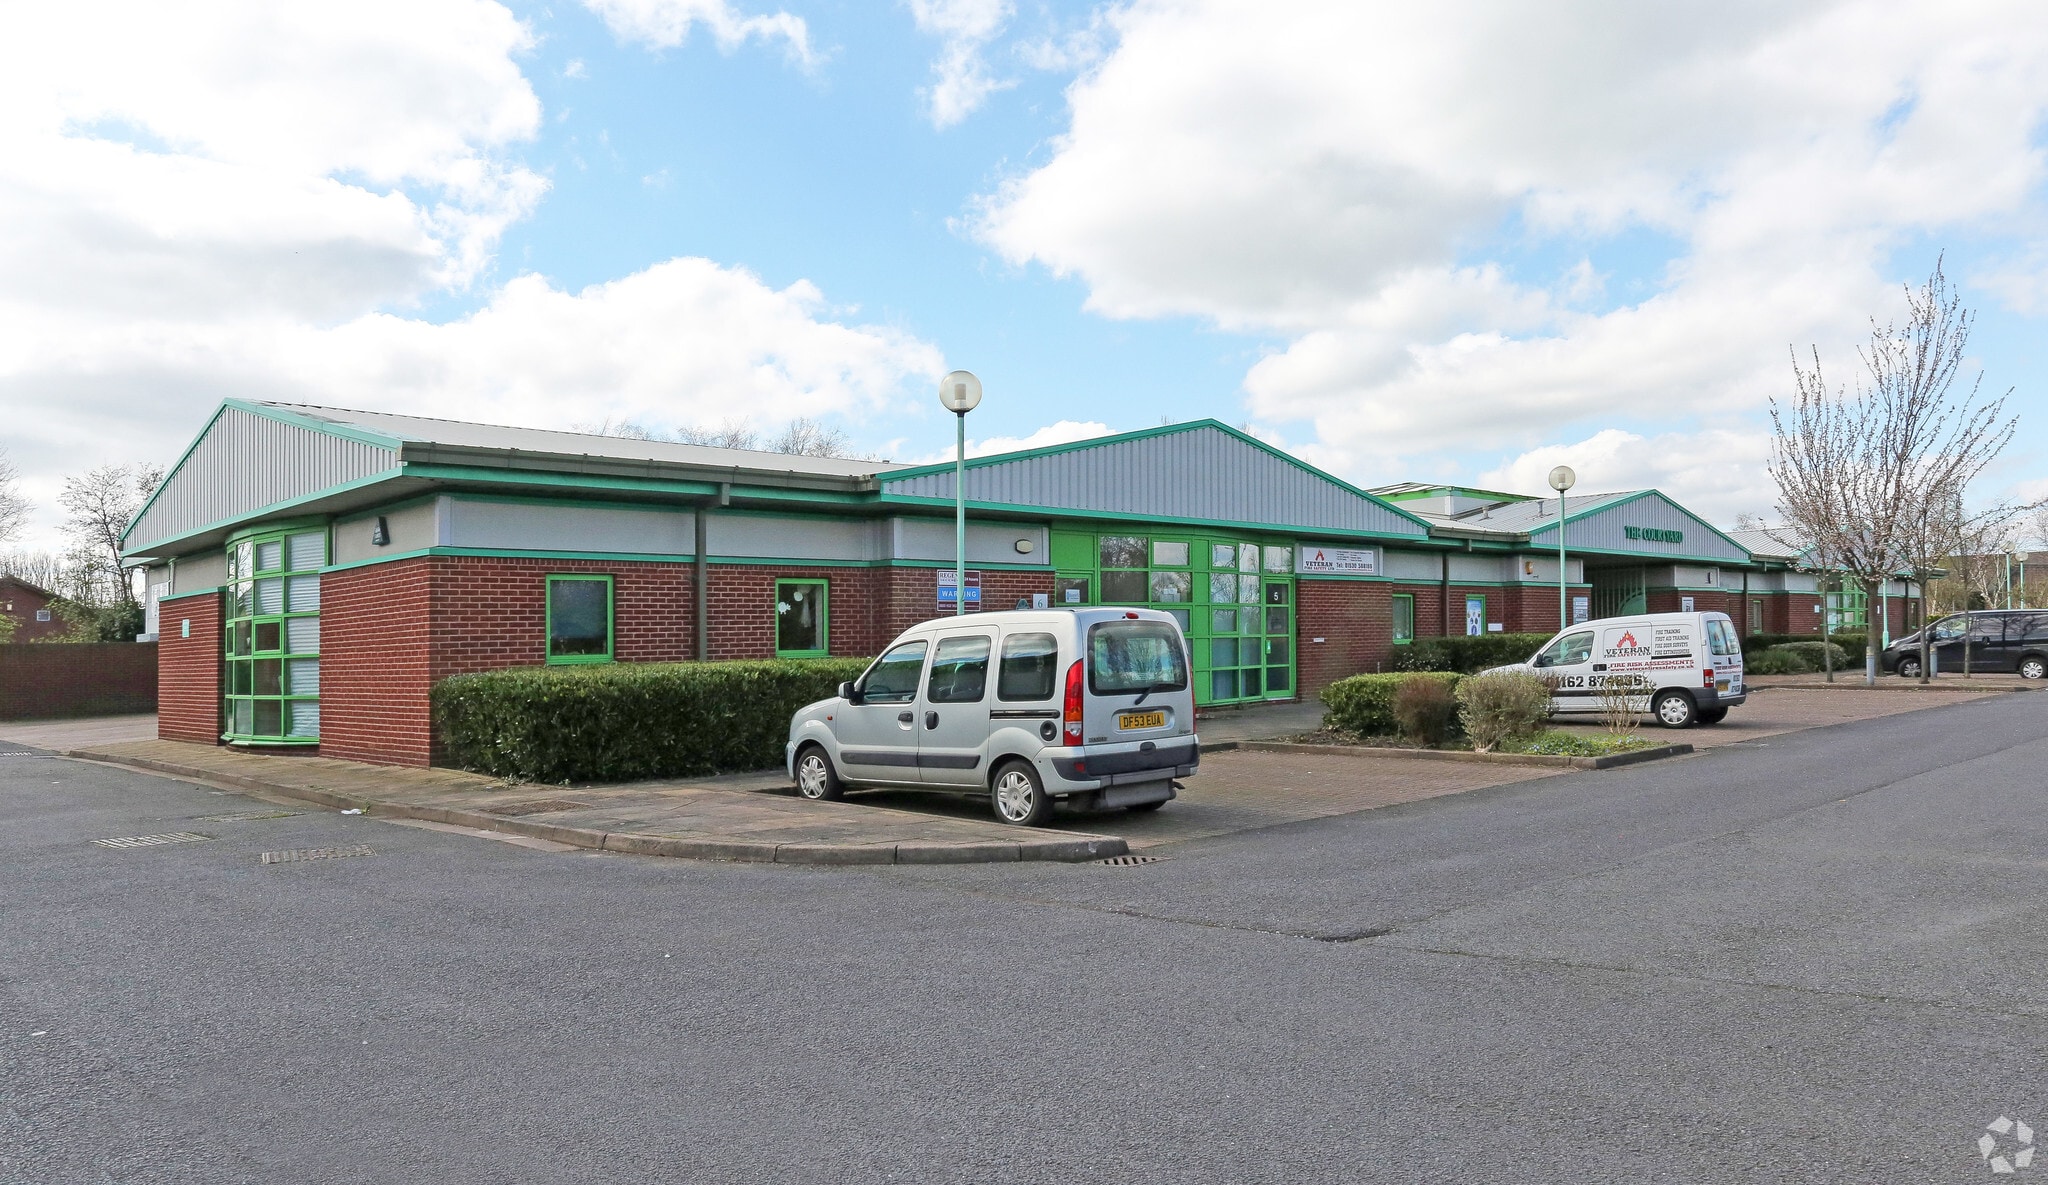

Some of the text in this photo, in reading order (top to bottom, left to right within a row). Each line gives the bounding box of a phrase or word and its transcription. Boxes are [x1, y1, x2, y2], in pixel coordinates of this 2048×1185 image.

[1624, 525, 1684, 543] THE COURTYARD
[941, 590, 977, 598] WARING
[1274, 592, 1278, 600] 5
[1037, 599, 1043, 608] 6
[1605, 646, 1650, 655] VETERAN
[1123, 714, 1161, 728] DF53 EUA
